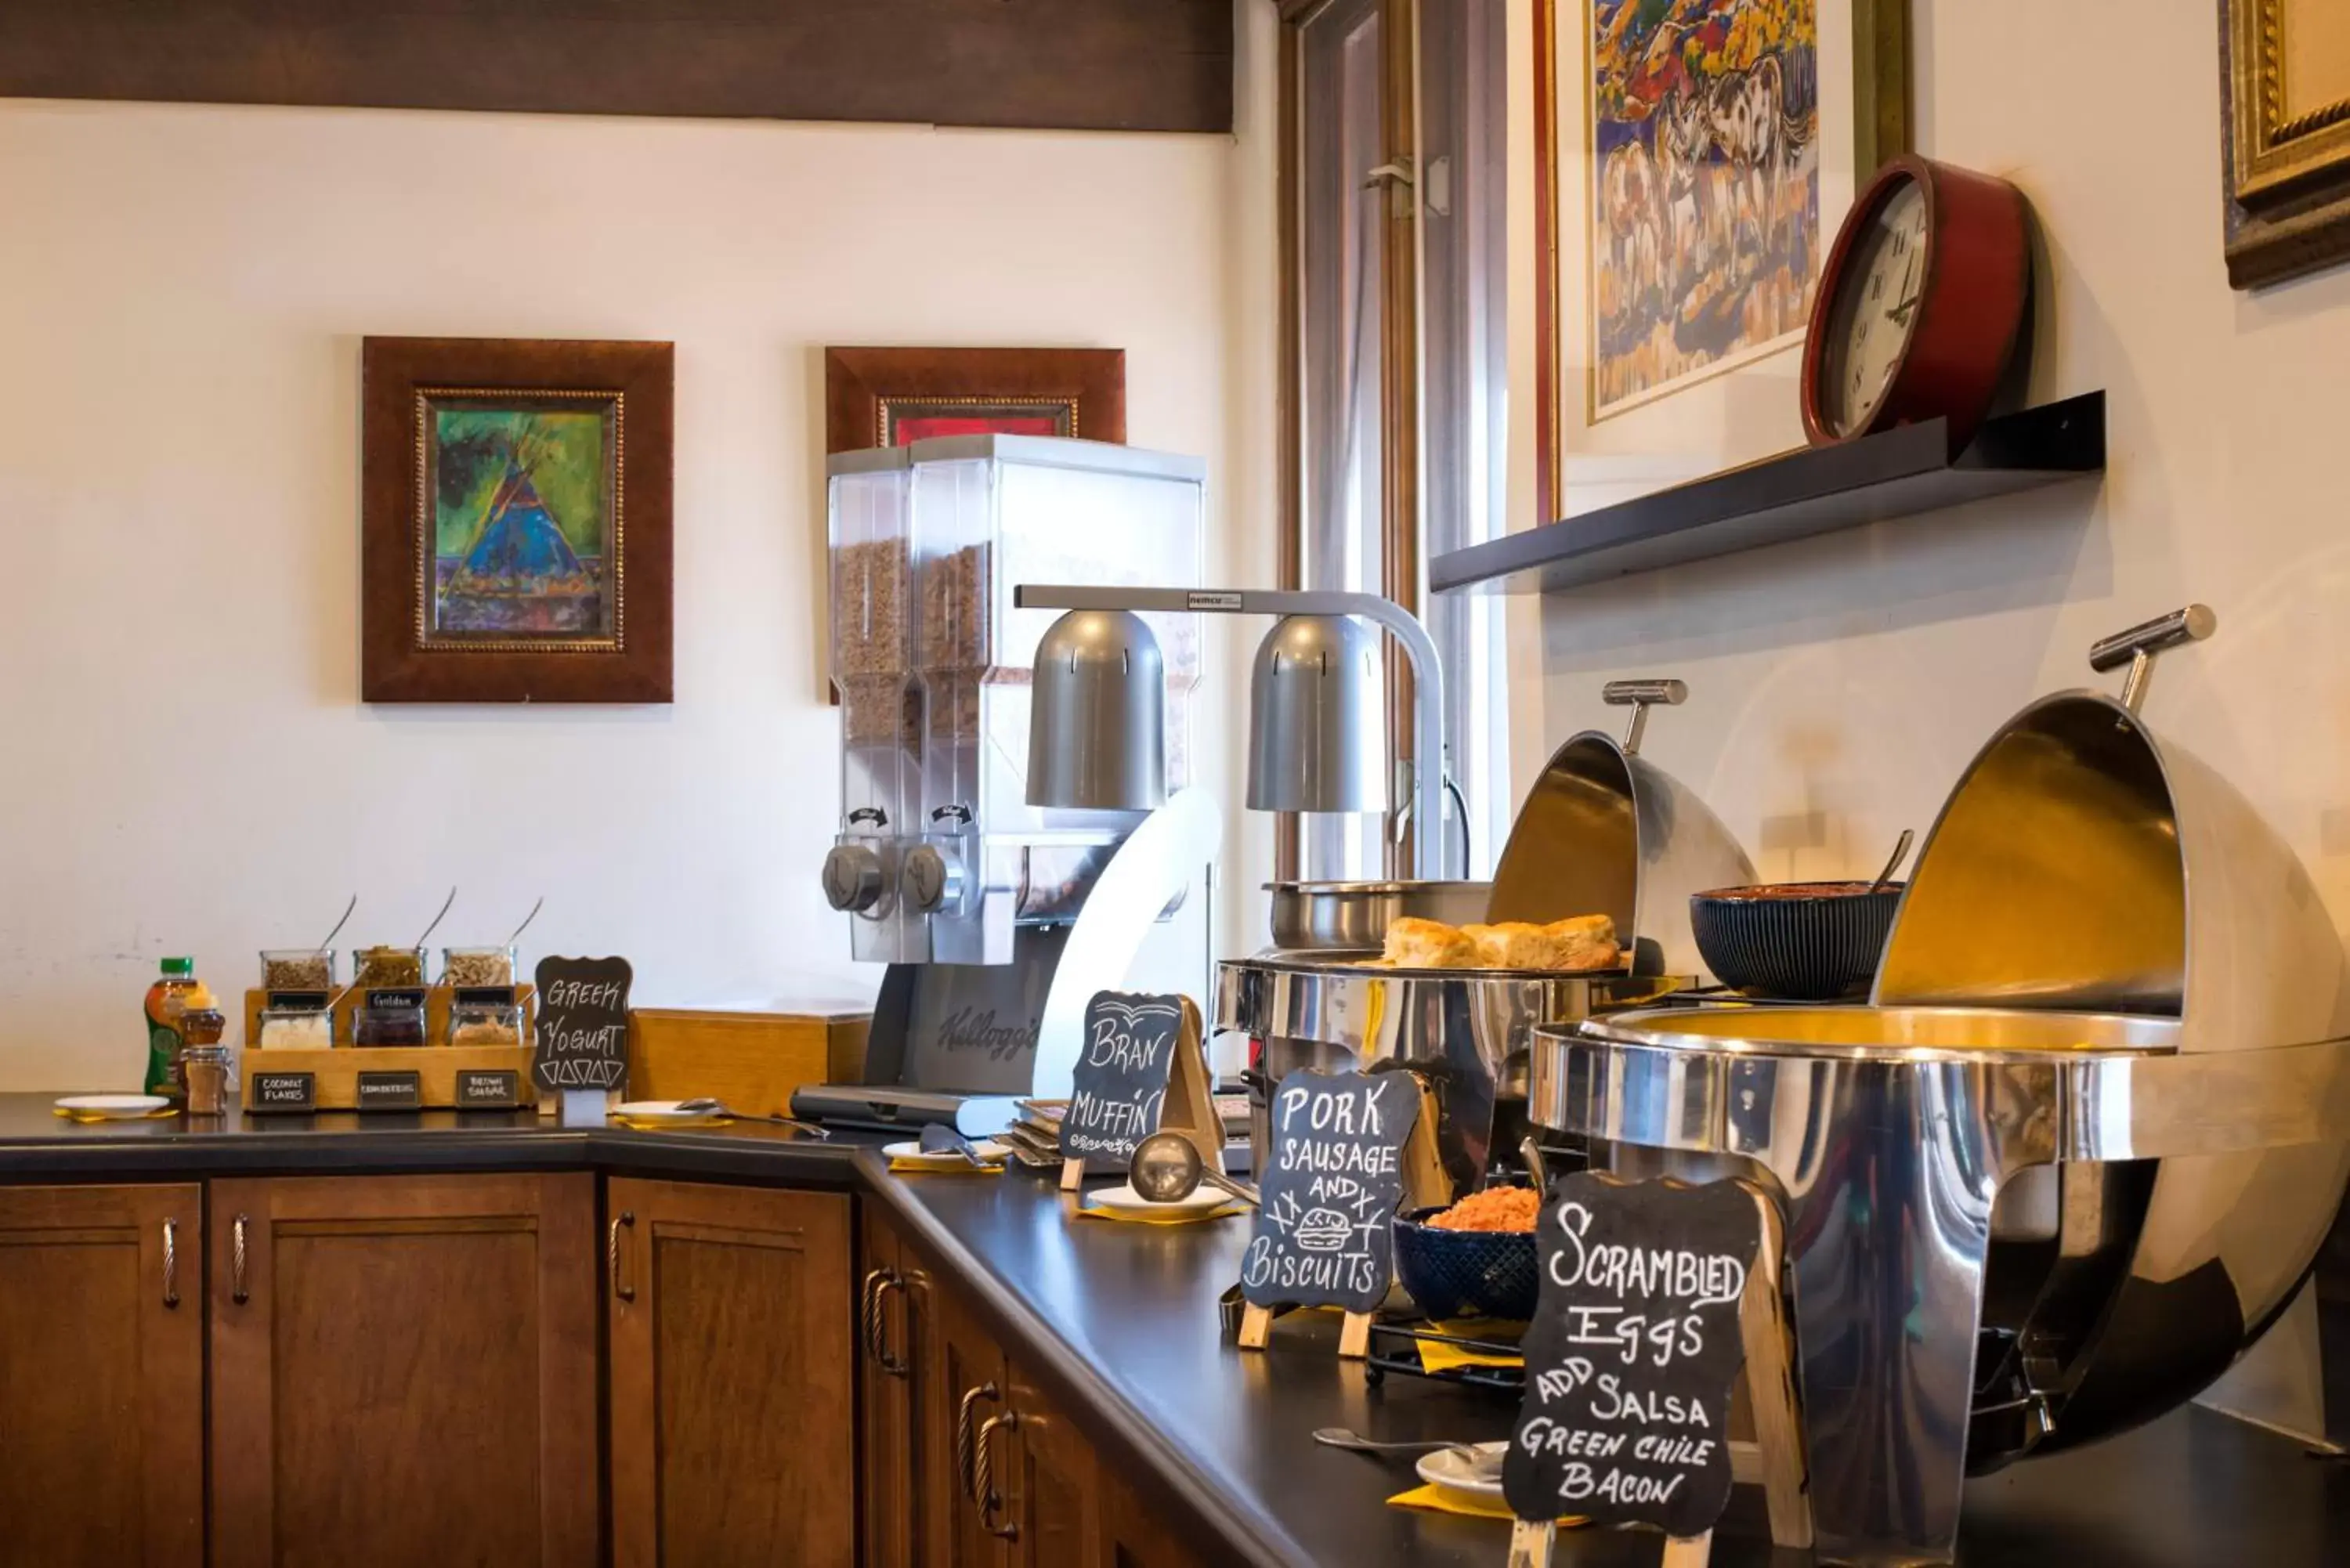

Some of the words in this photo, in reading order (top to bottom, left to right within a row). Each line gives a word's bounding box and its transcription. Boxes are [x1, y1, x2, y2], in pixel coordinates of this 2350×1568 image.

[548, 979, 621, 1012] GREEK
[543, 1015, 627, 1059] YOGURT
[1088, 1017, 1168, 1075] BRAN
[1071, 1088, 1162, 1136] MUFFIN
[1281, 1079, 1388, 1136] PORK
[1280, 1138, 1398, 1178] SAUSAGE
[1309, 1176, 1358, 1204] AND
[1549, 1201, 1746, 1310] SCRAMBLED
[1567, 1306, 1704, 1367] EGGS
[1535, 1357, 1594, 1404] ADD
[1590, 1374, 1711, 1429] SALSA
[1520, 1416, 1627, 1458] GREEN
[1634, 1434, 1716, 1467] CHILE
[1558, 1461, 1686, 1505] BACON
